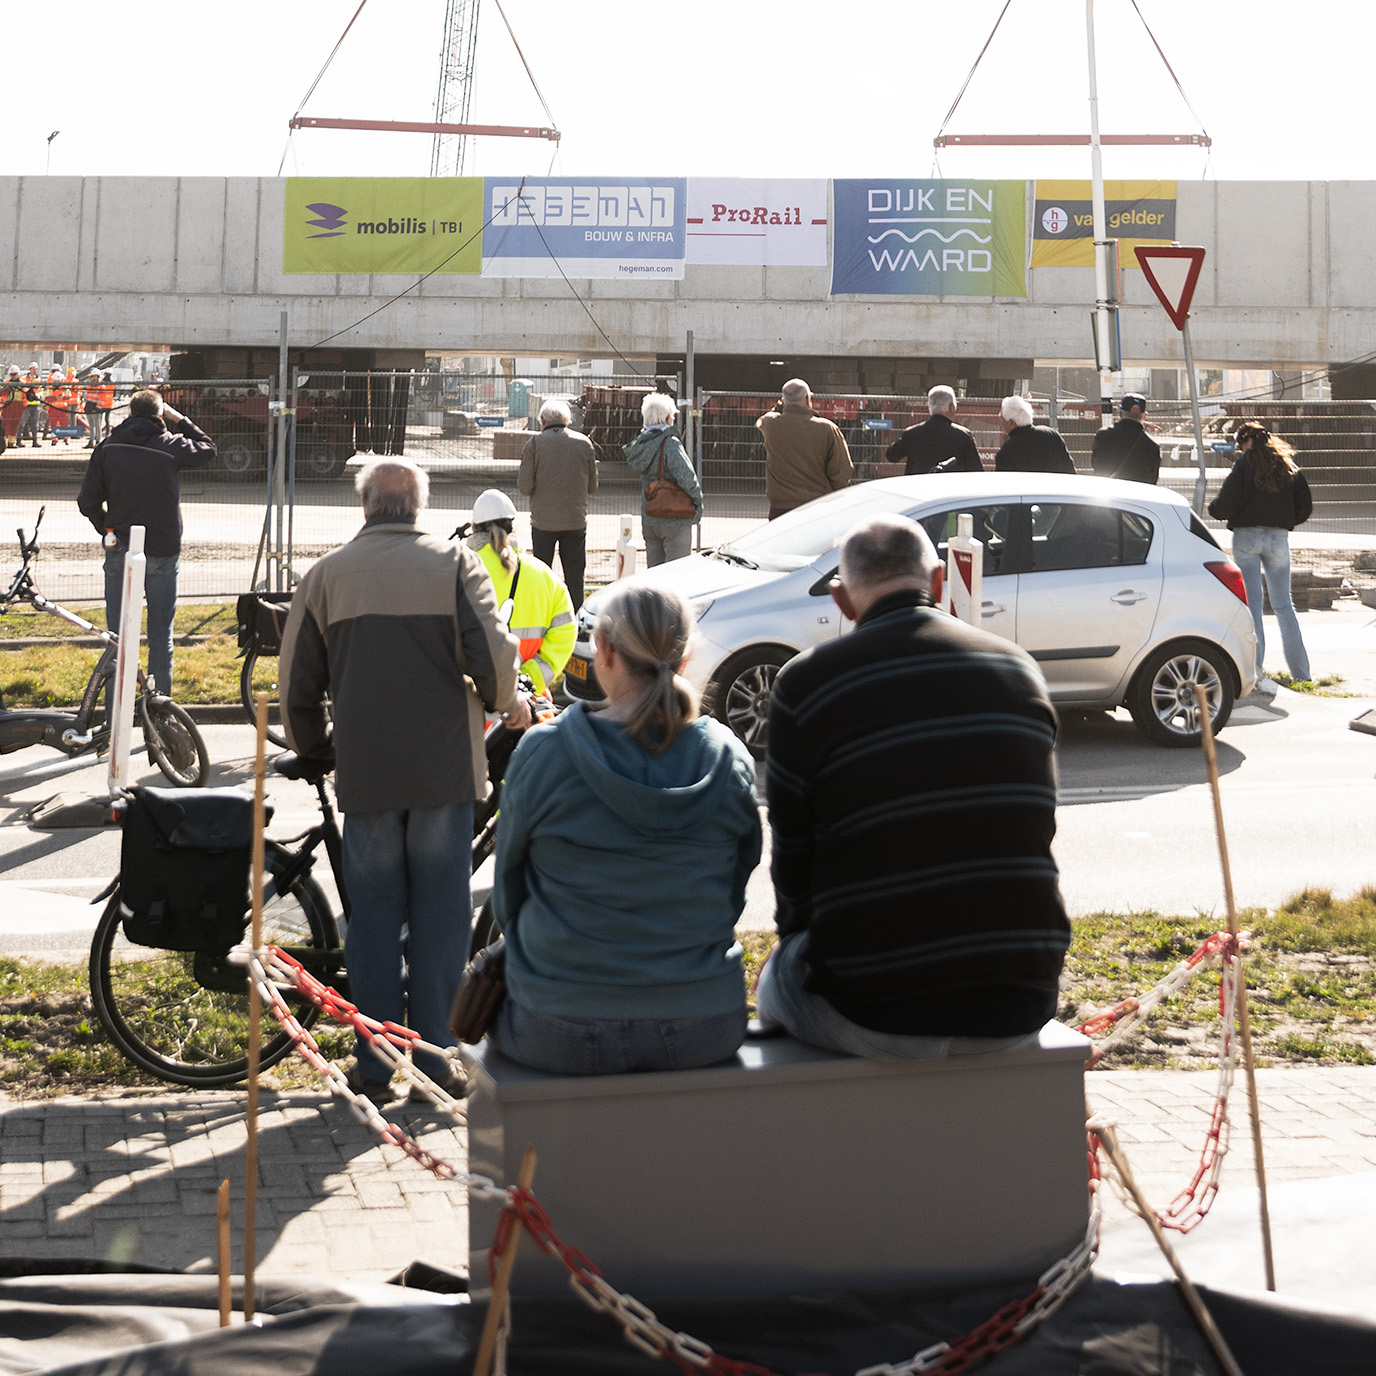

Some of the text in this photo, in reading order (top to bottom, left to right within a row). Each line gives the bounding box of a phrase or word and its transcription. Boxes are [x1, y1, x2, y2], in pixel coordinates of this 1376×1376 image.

[868, 188, 993, 212] DIJK EN
[712, 204, 802, 226] ProRail
[1074, 209, 1165, 229] va gelder
[357, 218, 462, 234] mobilis TBI
[584, 230, 674, 242] BOUW & INFRA
[618, 264, 673, 274] hegeman.com
[868, 248, 993, 272] WAARD
